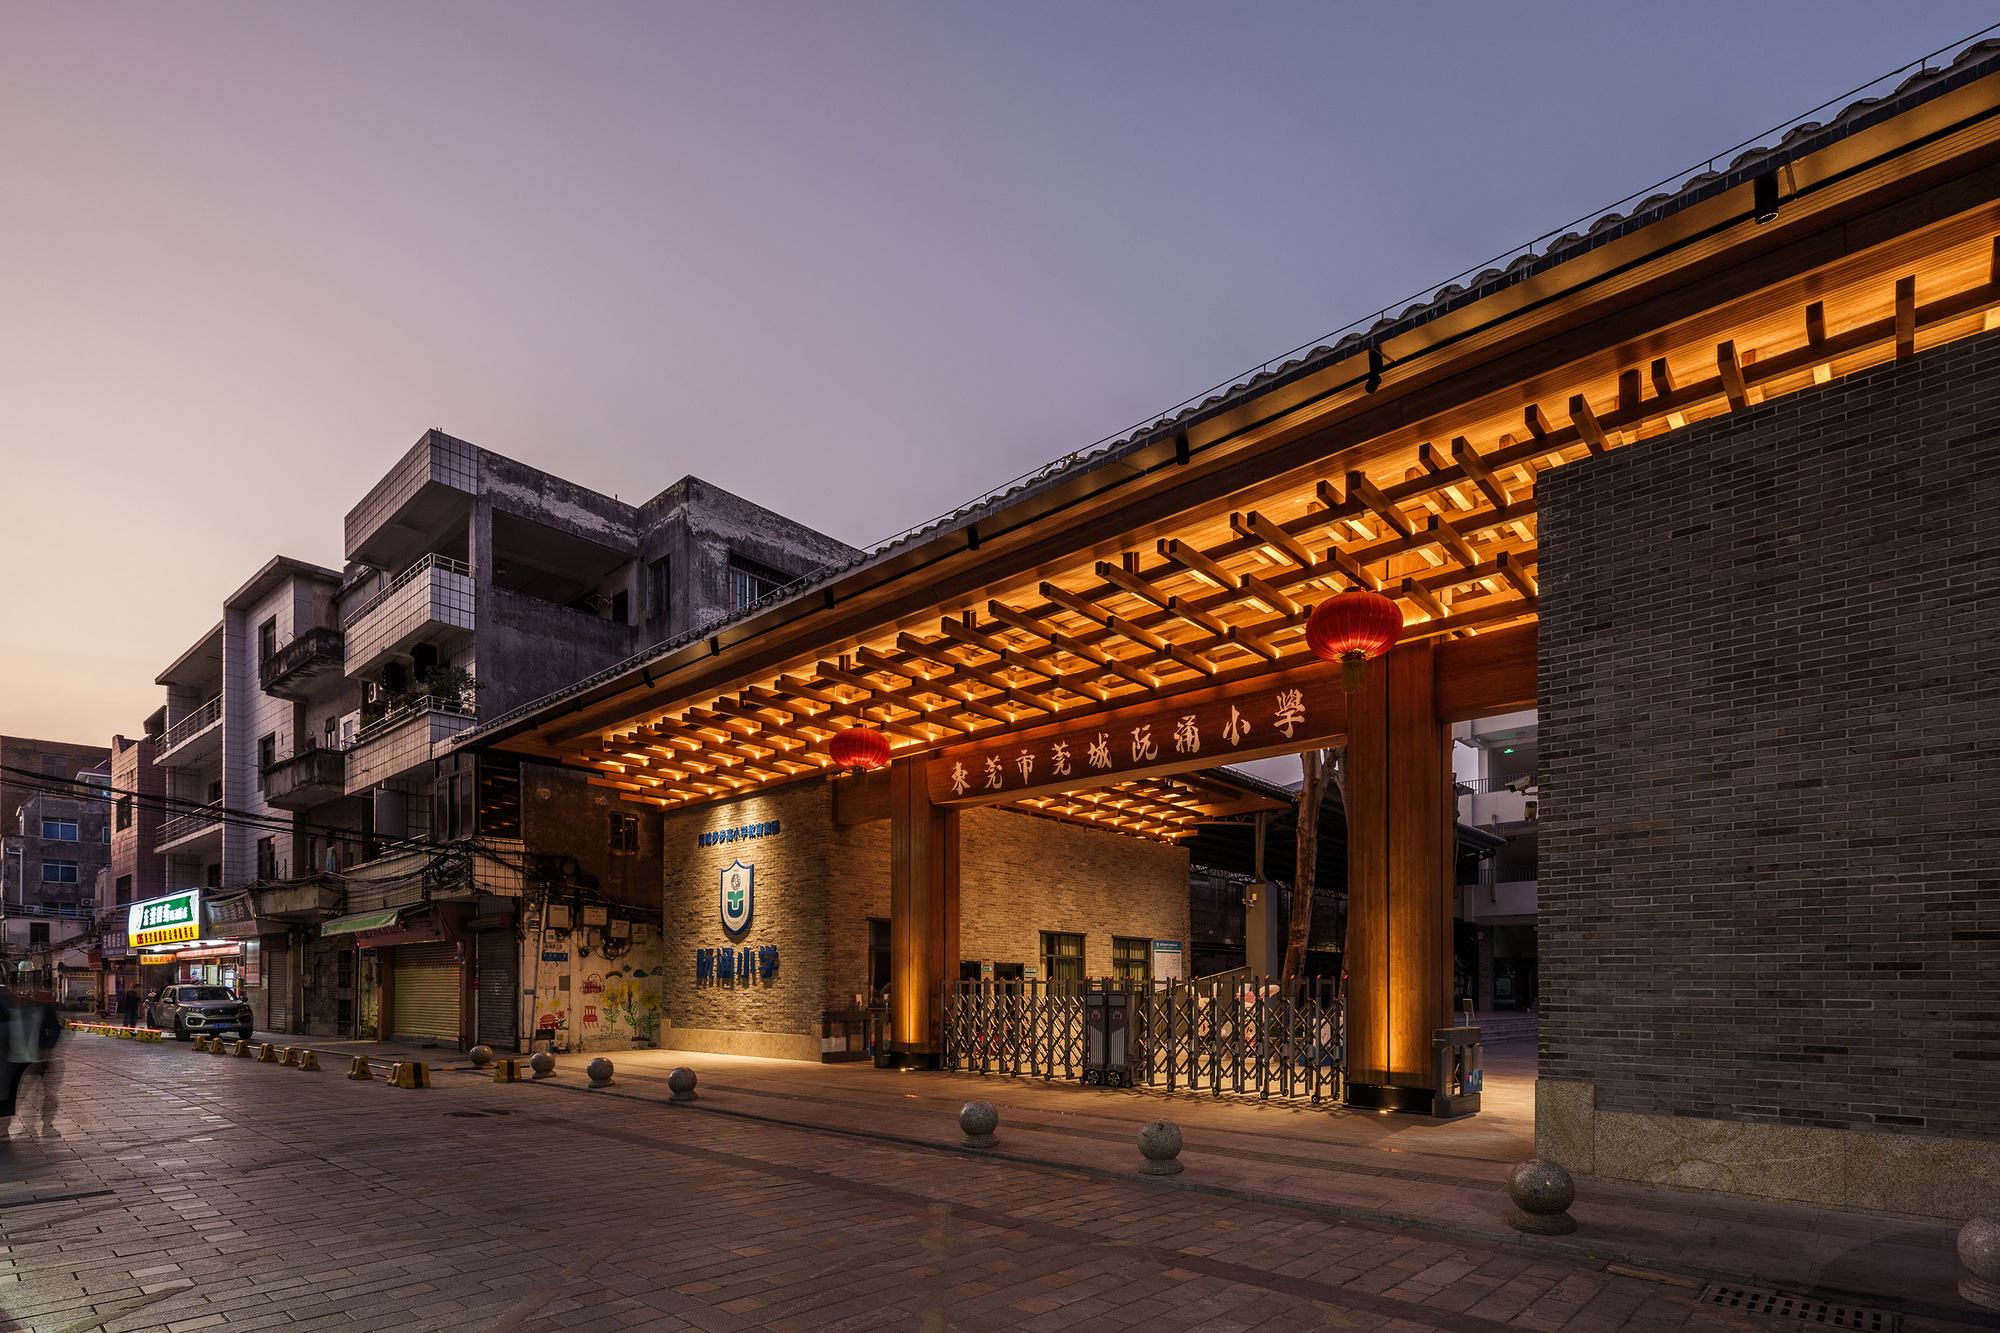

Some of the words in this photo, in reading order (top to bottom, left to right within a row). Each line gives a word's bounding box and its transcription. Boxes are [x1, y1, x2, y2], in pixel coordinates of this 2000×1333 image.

[697, 819, 780, 848] 莞城步步高小学教育集团
[696, 944, 779, 979] 阮涌小学
